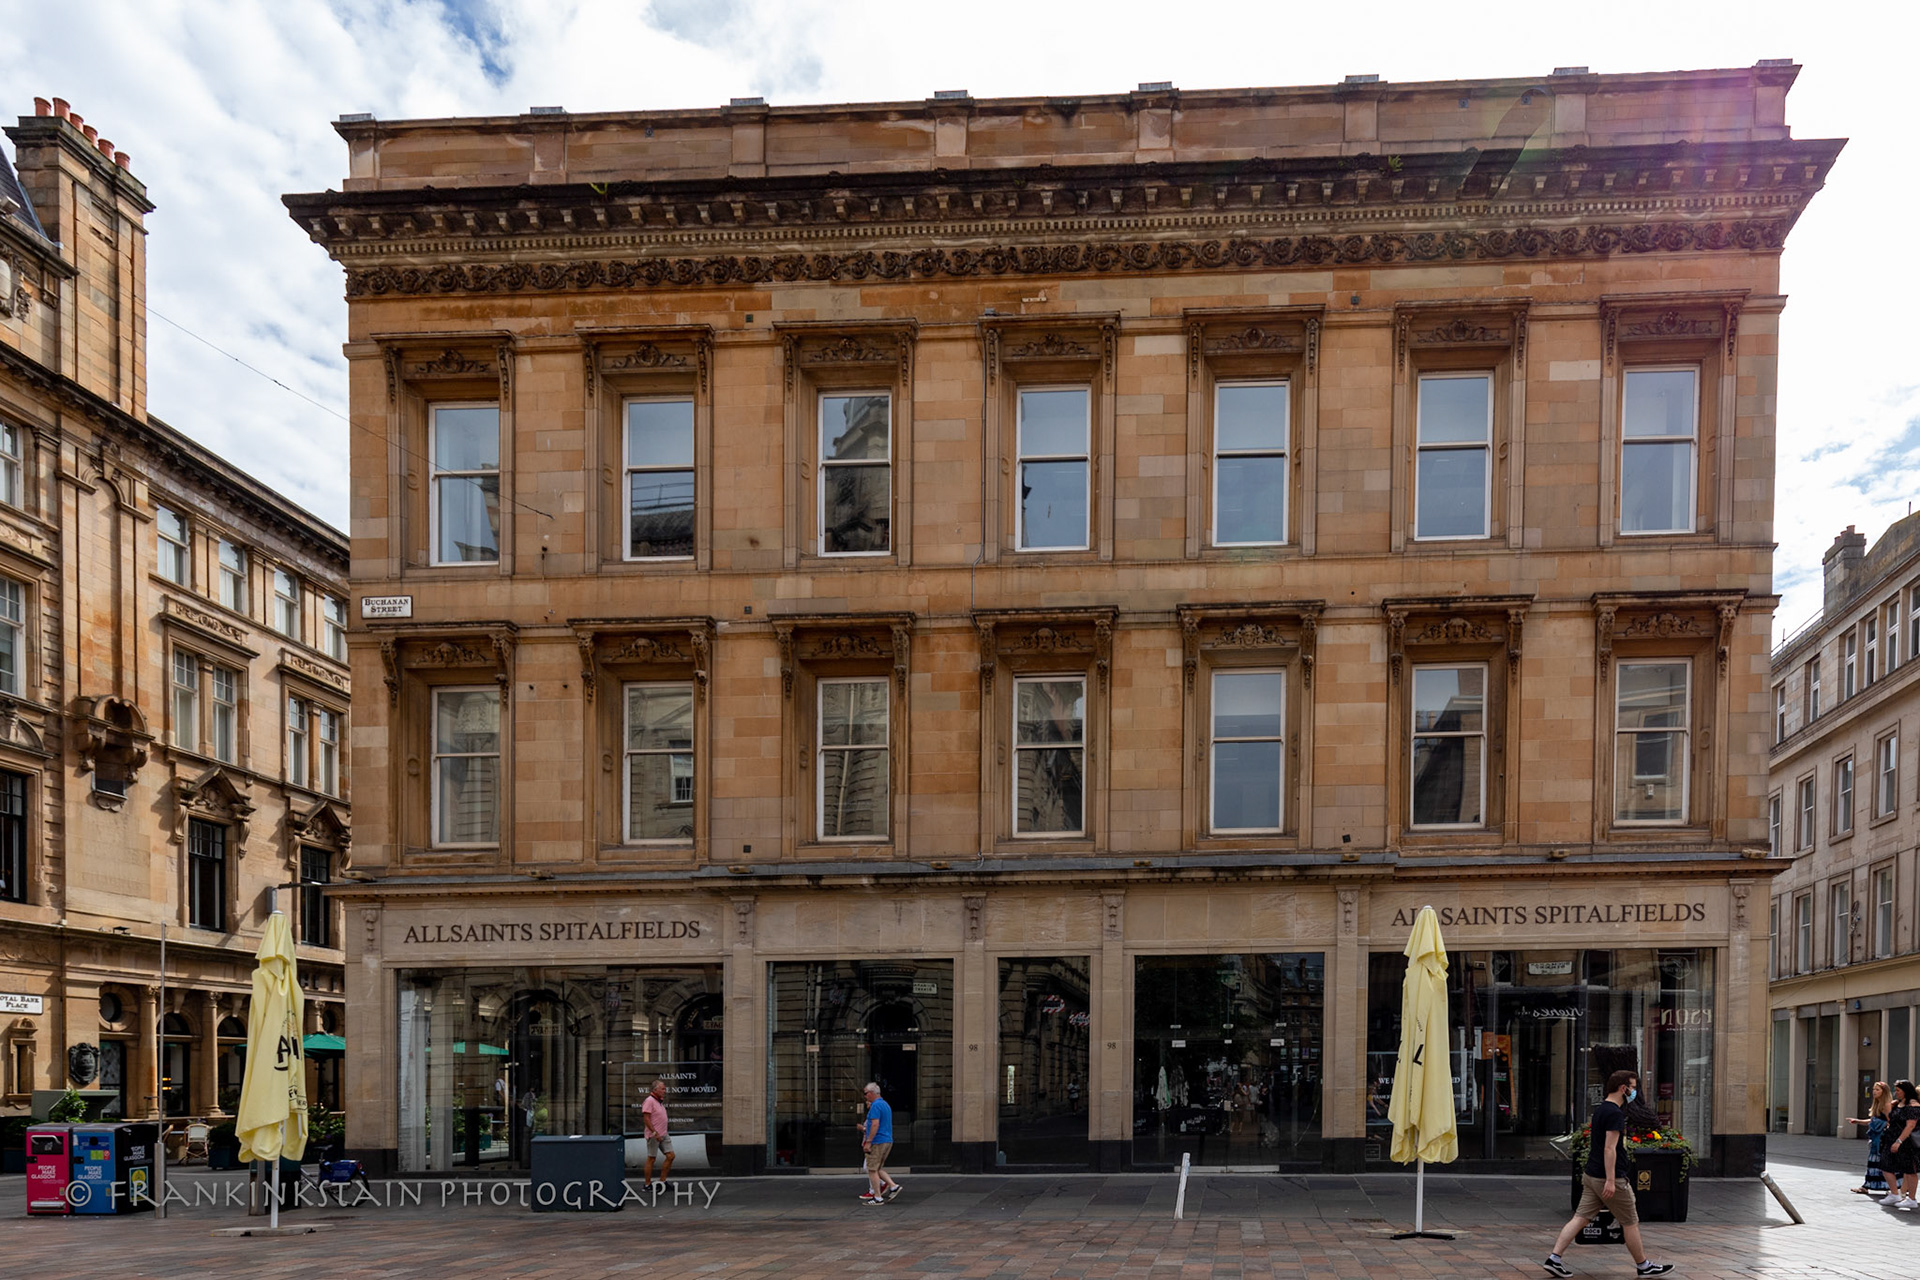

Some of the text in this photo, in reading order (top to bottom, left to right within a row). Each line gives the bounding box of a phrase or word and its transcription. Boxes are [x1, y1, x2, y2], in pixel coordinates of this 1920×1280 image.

[365, 598, 409, 606] BUCHANAN
[1391, 903, 1706, 926] ALSAINTS SPITALFIELDS
[404, 920, 701, 943] ALLSAINTS SPITALFIELDS
[1106, 1042, 1116, 1050] 98
